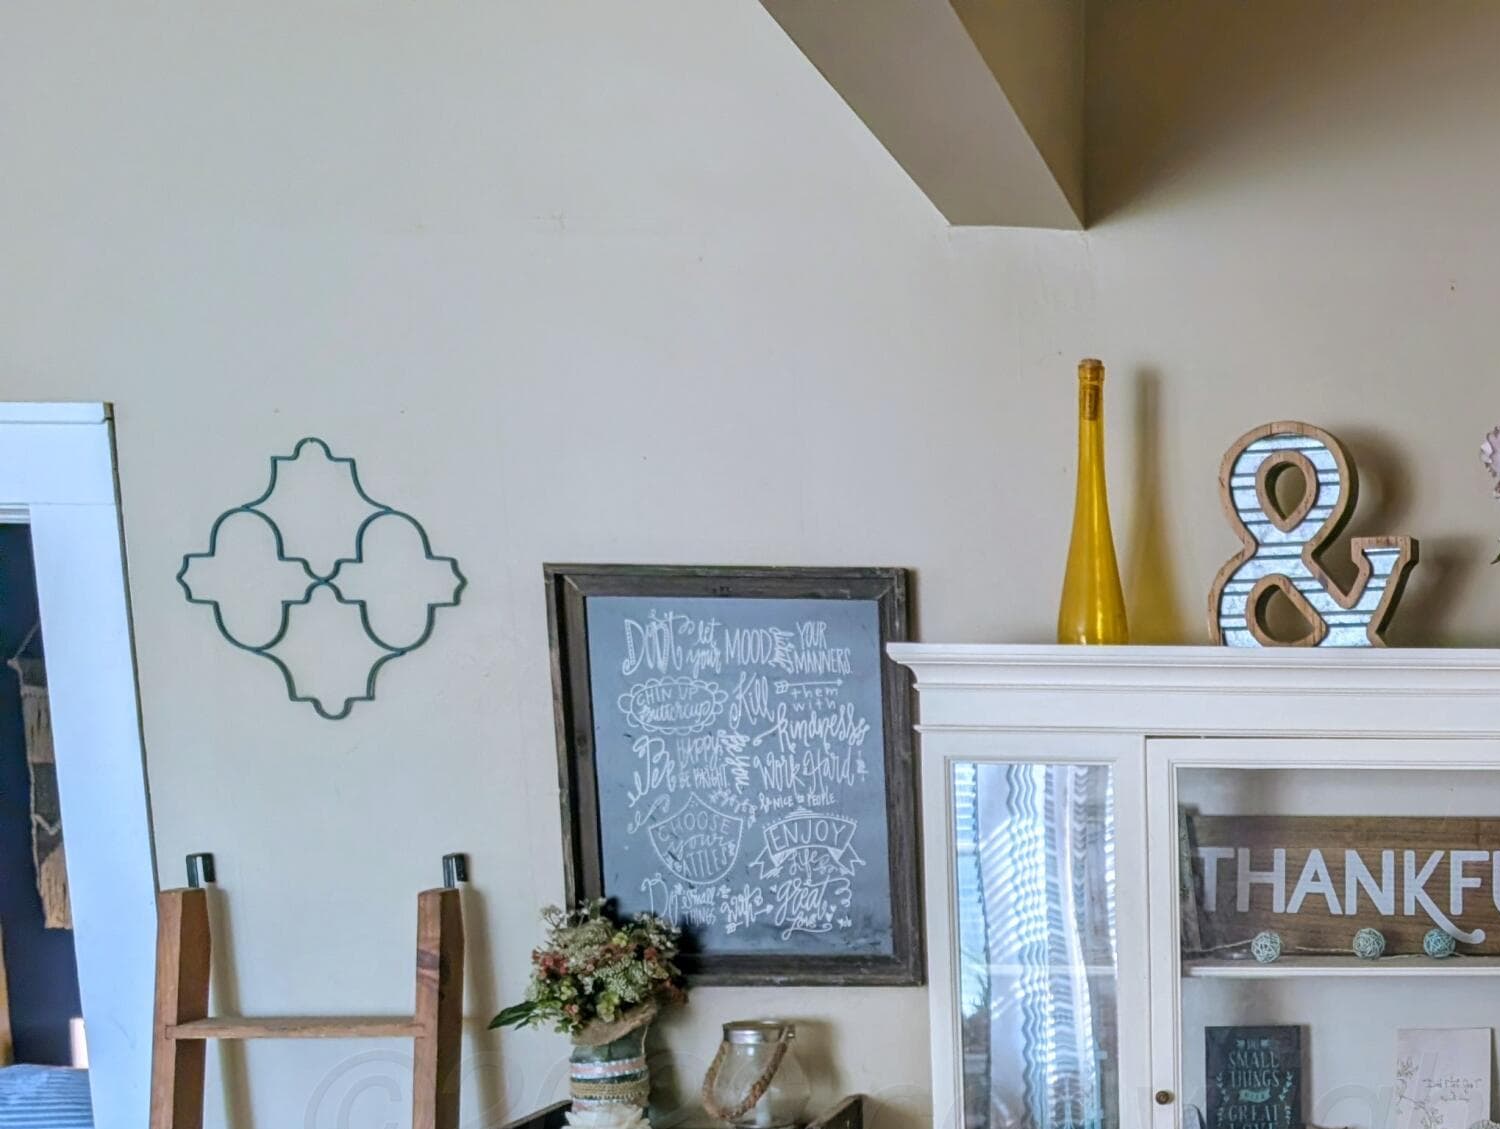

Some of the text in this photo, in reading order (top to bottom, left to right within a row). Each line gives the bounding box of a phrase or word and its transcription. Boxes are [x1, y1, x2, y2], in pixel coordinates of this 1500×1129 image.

[796, 621, 828, 650] YOUR
[725, 628, 772, 665] MOOD
[636, 684, 699, 706] CHIN UP
[790, 685, 839, 699] them
[793, 698, 836, 712] with
[658, 810, 732, 841] CHOOSE
[770, 819, 847, 851] ENJOY
[1228, 1051, 1280, 1069] SMALL
[1230, 1070, 1280, 1088] THINGS
[1228, 1104, 1278, 1122] GREAT
